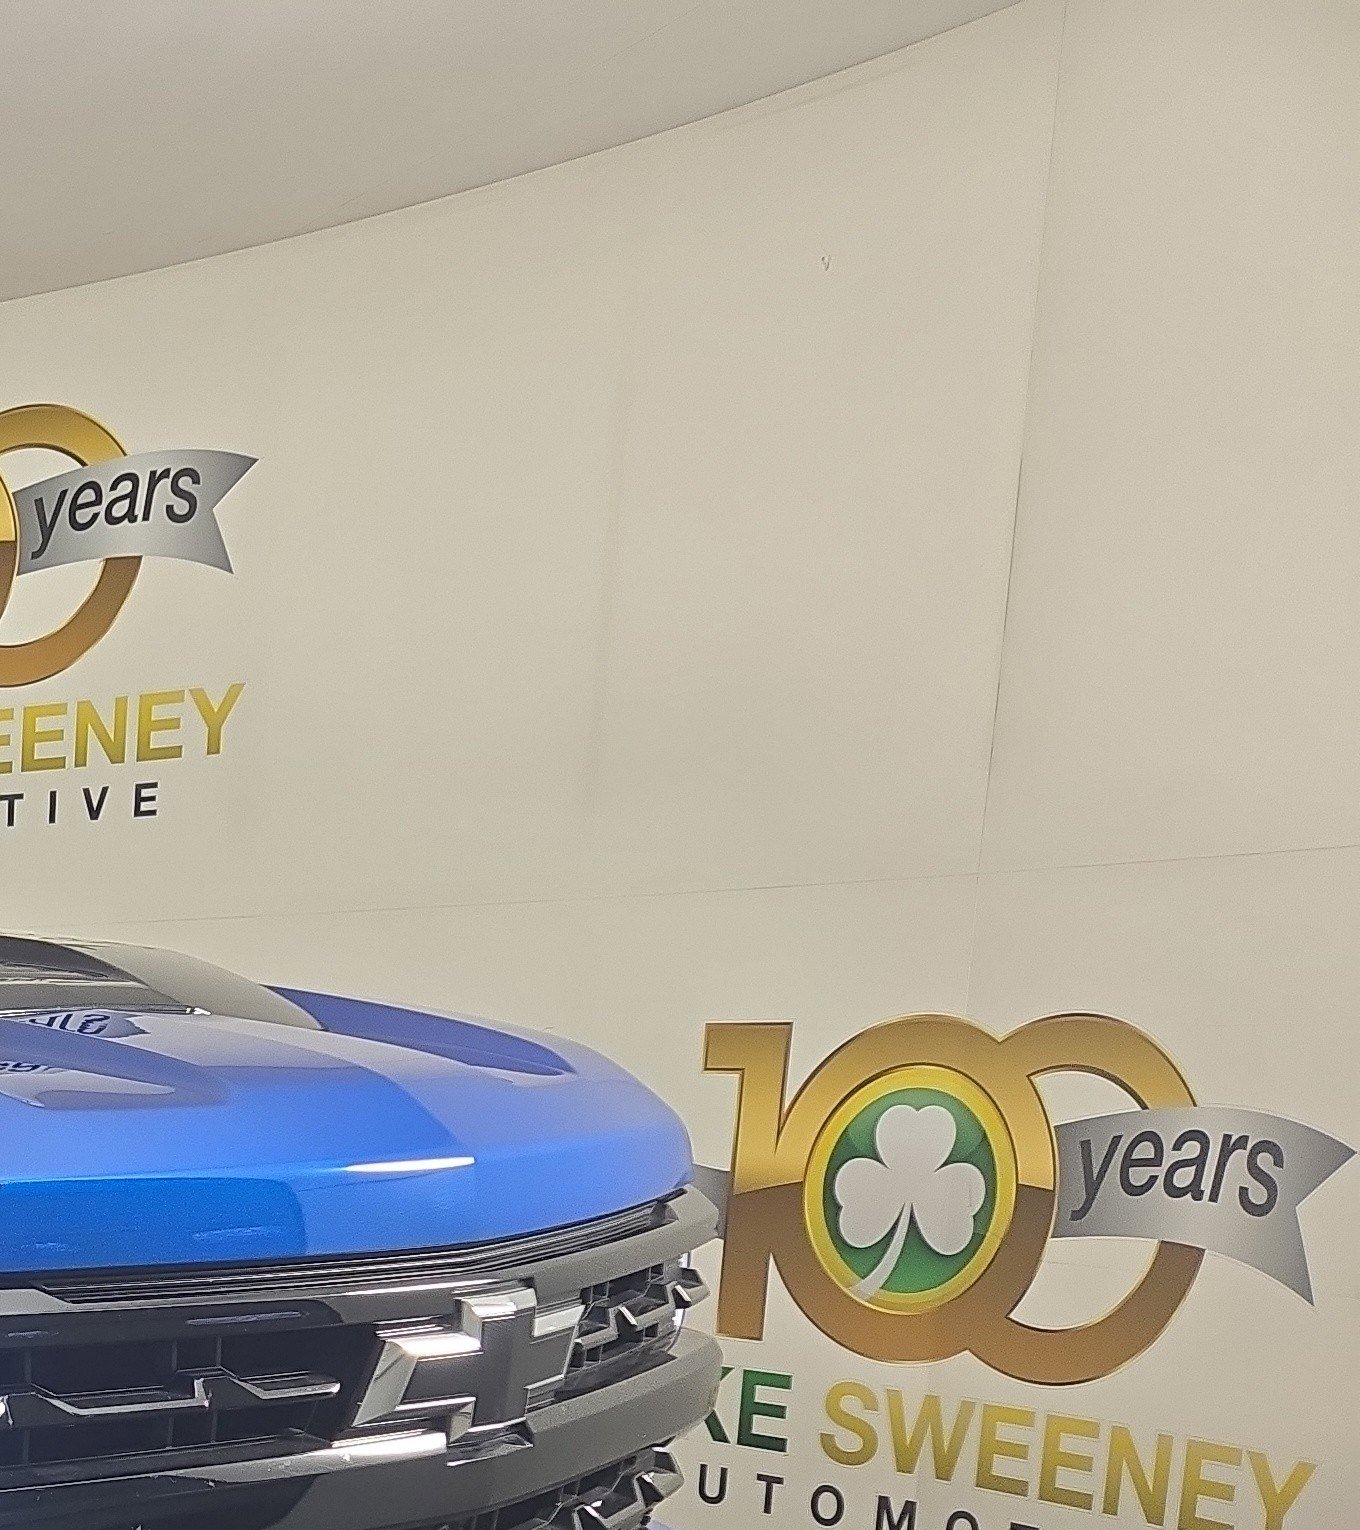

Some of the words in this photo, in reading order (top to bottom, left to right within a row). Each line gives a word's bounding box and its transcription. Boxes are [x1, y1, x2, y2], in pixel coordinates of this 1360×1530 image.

[30, 465, 200, 560] years
[703, 1012, 1203, 1386] 100
[1070, 1129, 1286, 1222] years
